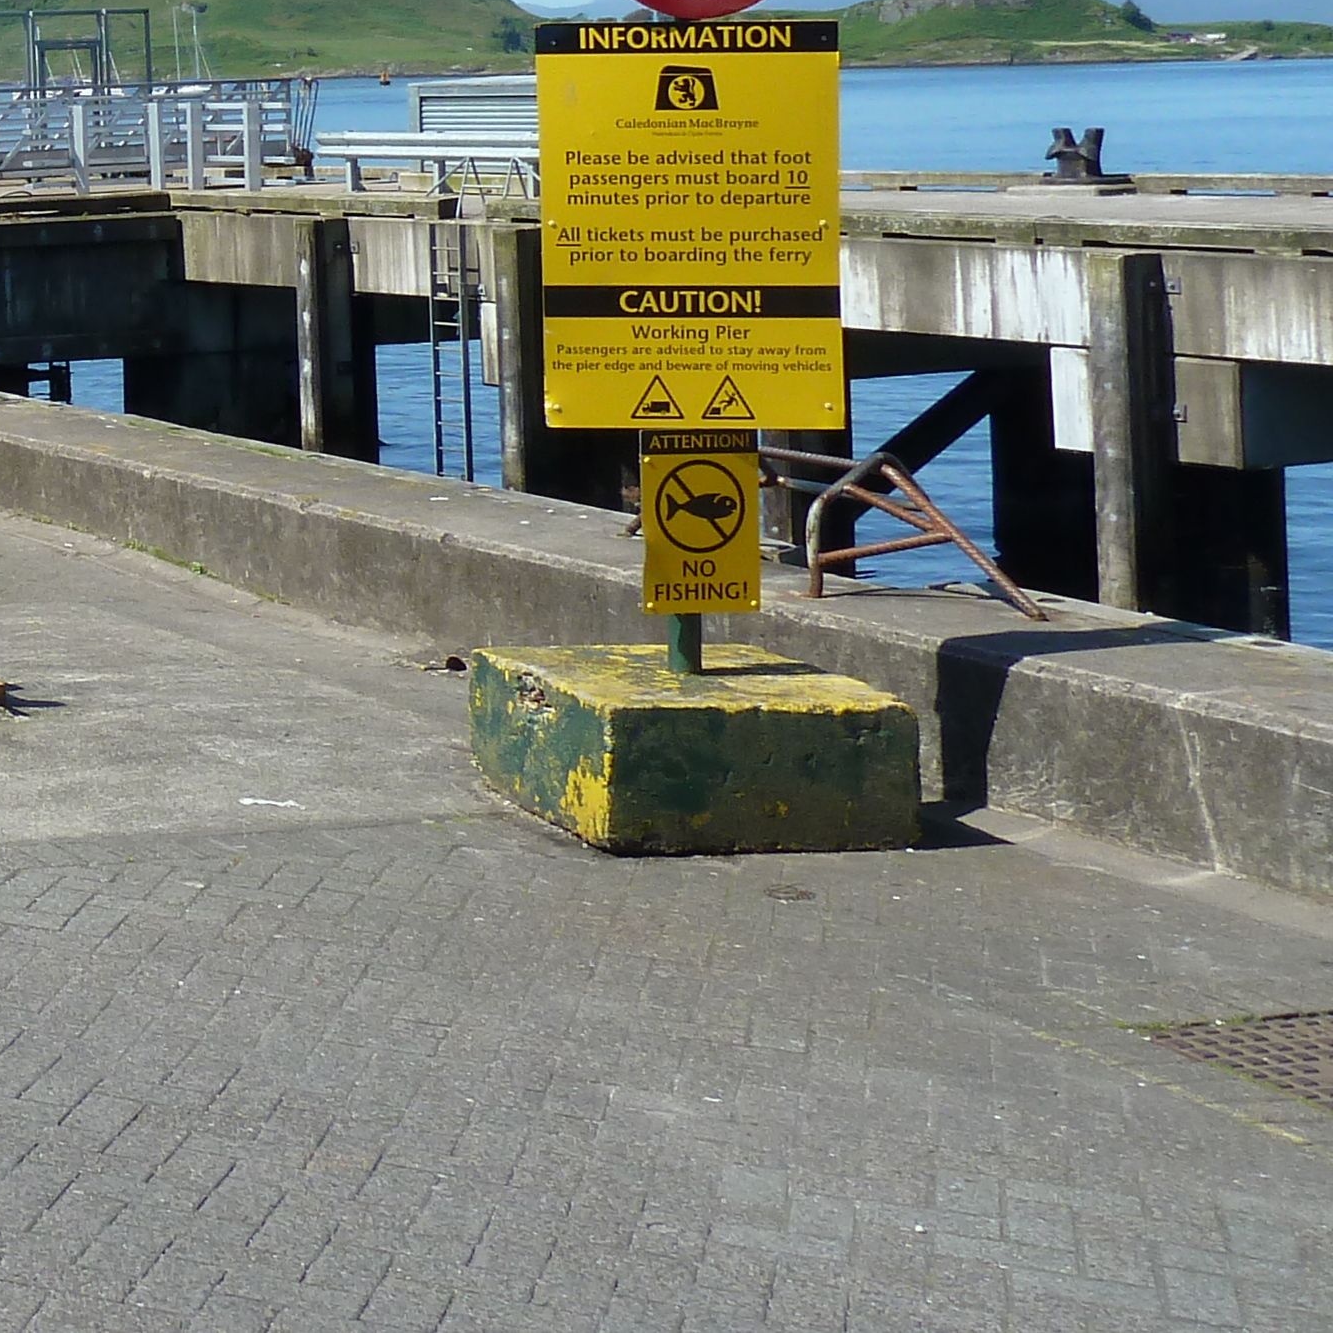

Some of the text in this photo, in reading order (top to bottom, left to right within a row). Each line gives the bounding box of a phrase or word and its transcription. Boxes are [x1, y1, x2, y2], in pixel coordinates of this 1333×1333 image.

[579, 25, 792, 50] INFORMATION
[615, 119, 760, 131] Caledonian MacBrayne
[565, 151, 812, 165] Please be advised that foot
[569, 171, 809, 189] passengers must board 10
[567, 191, 811, 209] minutes prior to departure
[557, 227, 823, 245] All tickets must be purchased
[569, 247, 812, 266] prior to boarding the ferry
[619, 290, 762, 313] CAUTION!
[631, 324, 751, 343] Working Pier
[556, 344, 827, 358] Passengers are advised to stay away from
[552, 360, 833, 374] the pier edge and beware of moving vehicles
[649, 434, 751, 450] ATTENTION!
[683, 560, 716, 577] NO
[654, 582, 749, 602] FISHING!
